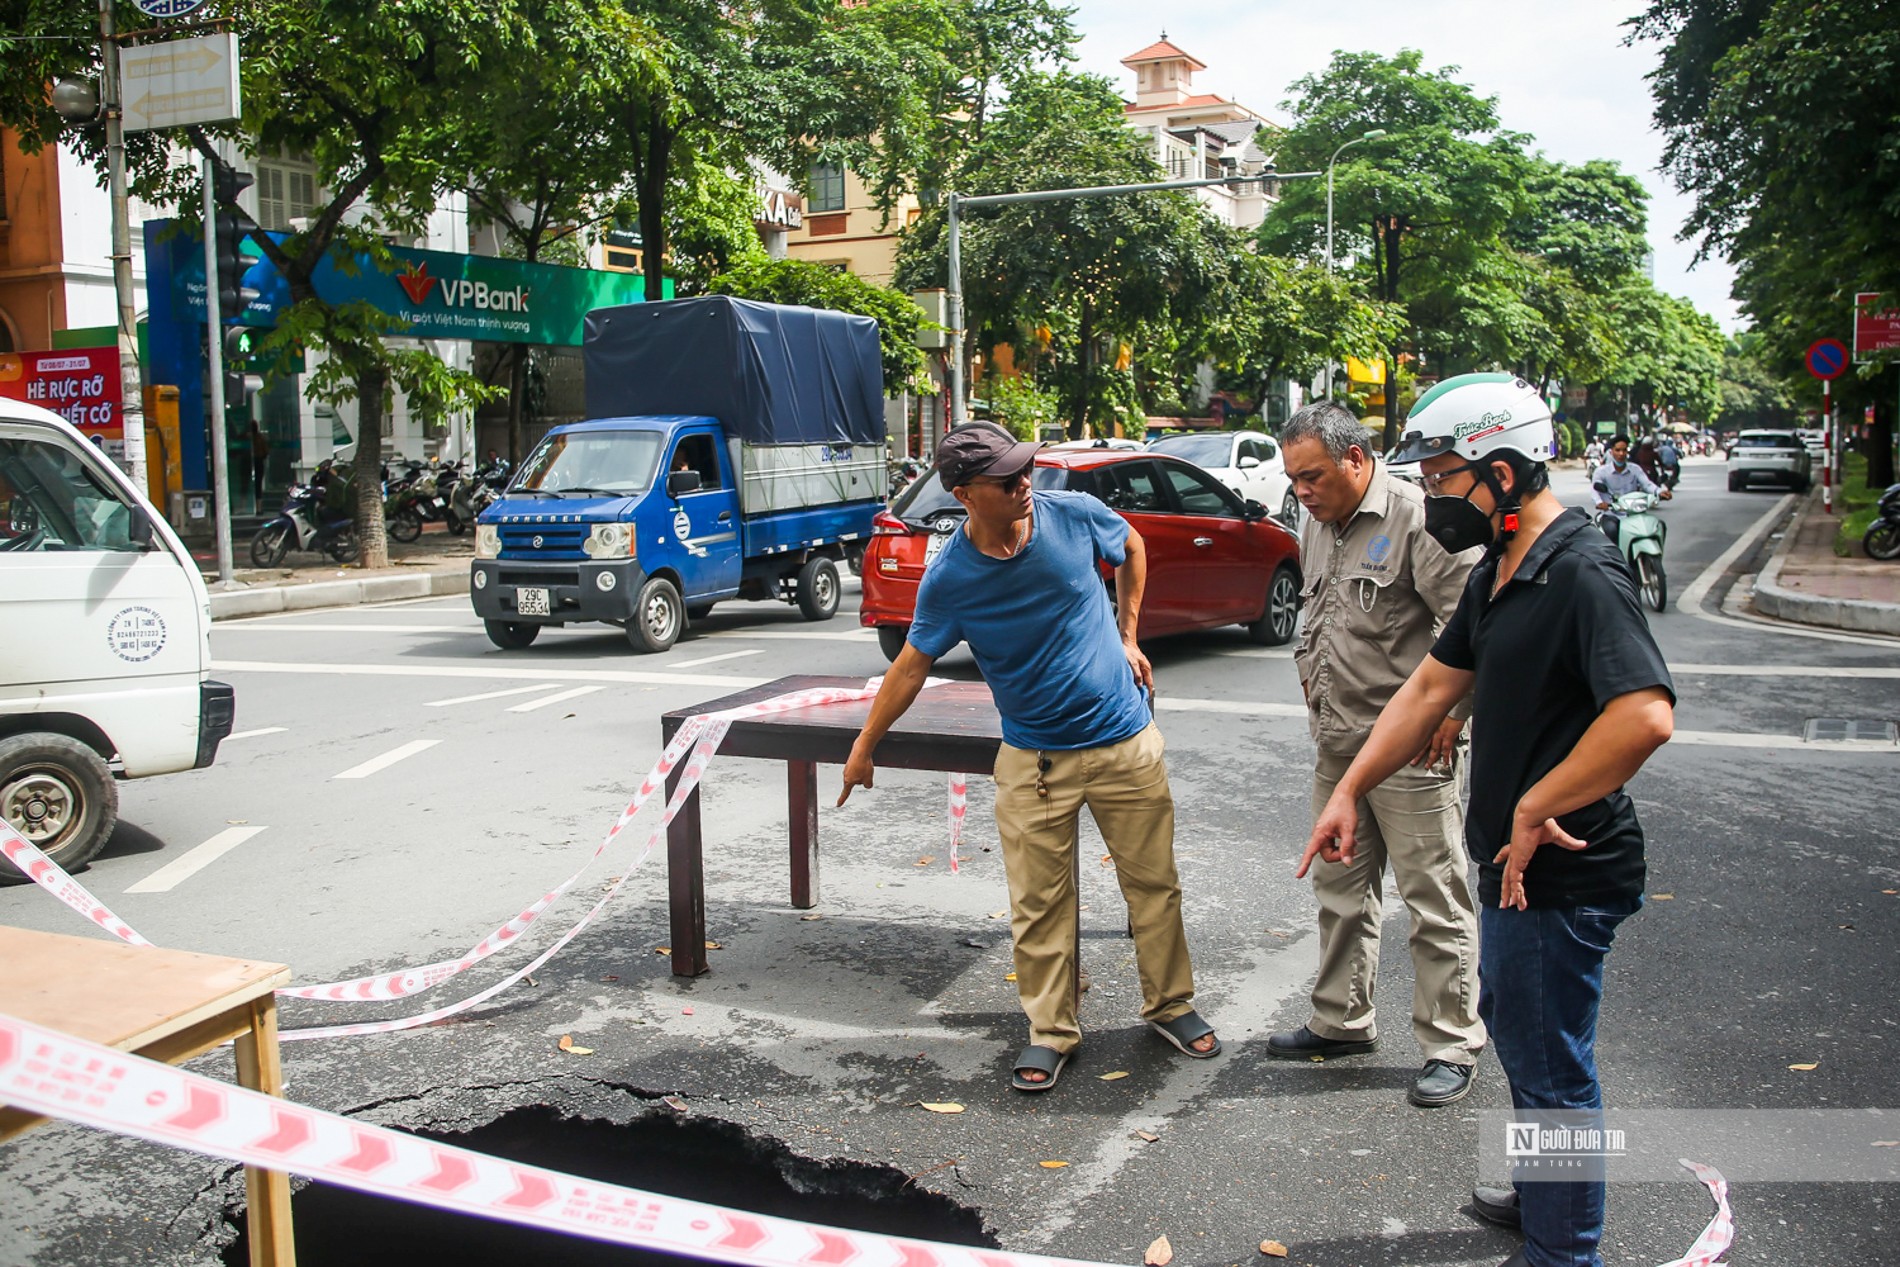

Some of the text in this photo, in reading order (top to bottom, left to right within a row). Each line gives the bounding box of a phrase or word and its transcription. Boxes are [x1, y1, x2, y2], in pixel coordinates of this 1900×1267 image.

[440, 278, 529, 313] VPBank
[433, 313, 453, 328] Việt
[454, 314, 477, 327] Nam
[478, 317, 501, 331] thịnh
[502, 321, 530, 333] vượng
[27, 374, 104, 402] HÈ RỰC RỠ
[60, 401, 112, 424] HẾT CỠ
[524, 589, 542, 601] 29C
